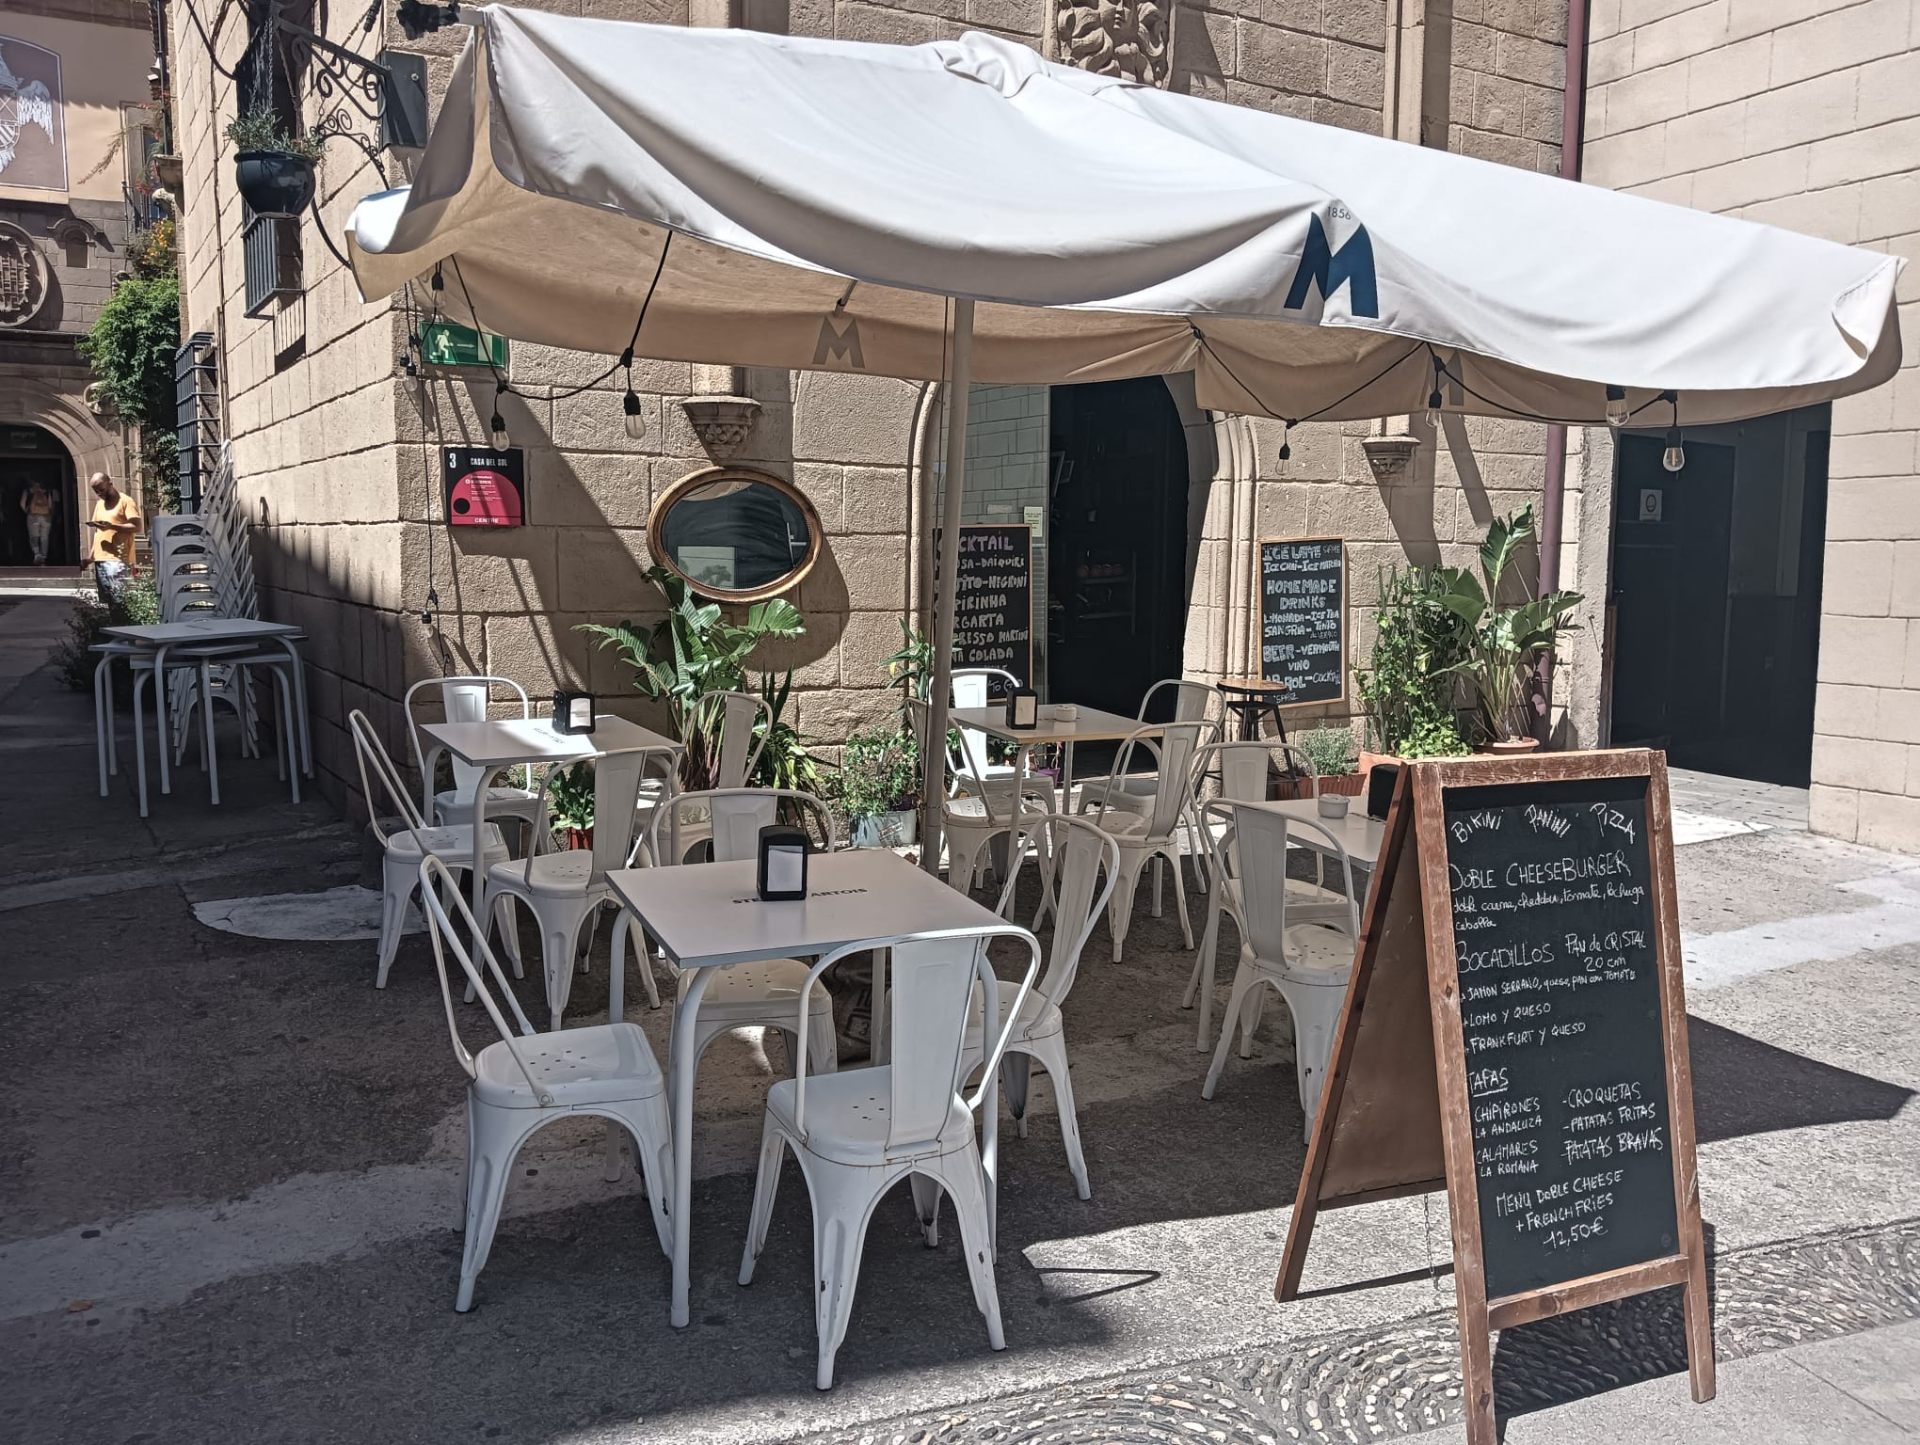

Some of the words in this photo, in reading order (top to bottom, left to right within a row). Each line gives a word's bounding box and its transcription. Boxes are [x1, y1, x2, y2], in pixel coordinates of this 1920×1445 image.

[1326, 206, 1351, 220] 1856
[1283, 211, 1379, 319] M
[812, 315, 865, 369] M
[449, 453, 456, 468] 3
[470, 458, 485, 466] CASA
[1262, 544, 1290, 561] ICE
[1280, 595, 1327, 610] DRINKS
[968, 647, 1014, 662] COLADA
[1288, 659, 1310, 671] VINO
[1590, 802, 1635, 844] PIZZA
[1449, 864, 1497, 892] DOBLE
[1506, 850, 1631, 886] CHEESEBURGER
[811, 888, 868, 898] ARTOIS
[1456, 939, 1554, 973] BOCADILLOS
[1565, 933, 1586, 957] PAN
[1589, 933, 1602, 951] de
[1605, 931, 1646, 951] CRISTAL
[1584, 956, 1603, 972] 20
[1607, 956, 1626, 968] cm
[1470, 1012, 1498, 1027] LOMO
[1513, 1002, 1551, 1020] QUESO
[1469, 1029, 1535, 1054] FRANKFURT
[1551, 1022, 1586, 1037] QUESO
[1476, 1128, 1487, 1138] LA
[1491, 1115, 1543, 1136] ANDALUZA
[1617, 1102, 1656, 1124] FRITAS
[1476, 1139, 1539, 1164] CALAMARES
[1616, 1127, 1664, 1153] BRAVAS
[1480, 1166, 1492, 1177] LA
[1497, 1159, 1540, 1175] ROMANA
[1496, 1192, 1533, 1217] MENU
[1536, 1181, 1569, 1204] DOBLE
[1572, 1170, 1624, 1193] CHEESE
[1575, 1193, 1614, 1217] FRIES
[1543, 1216, 1609, 1249] 12,50€
